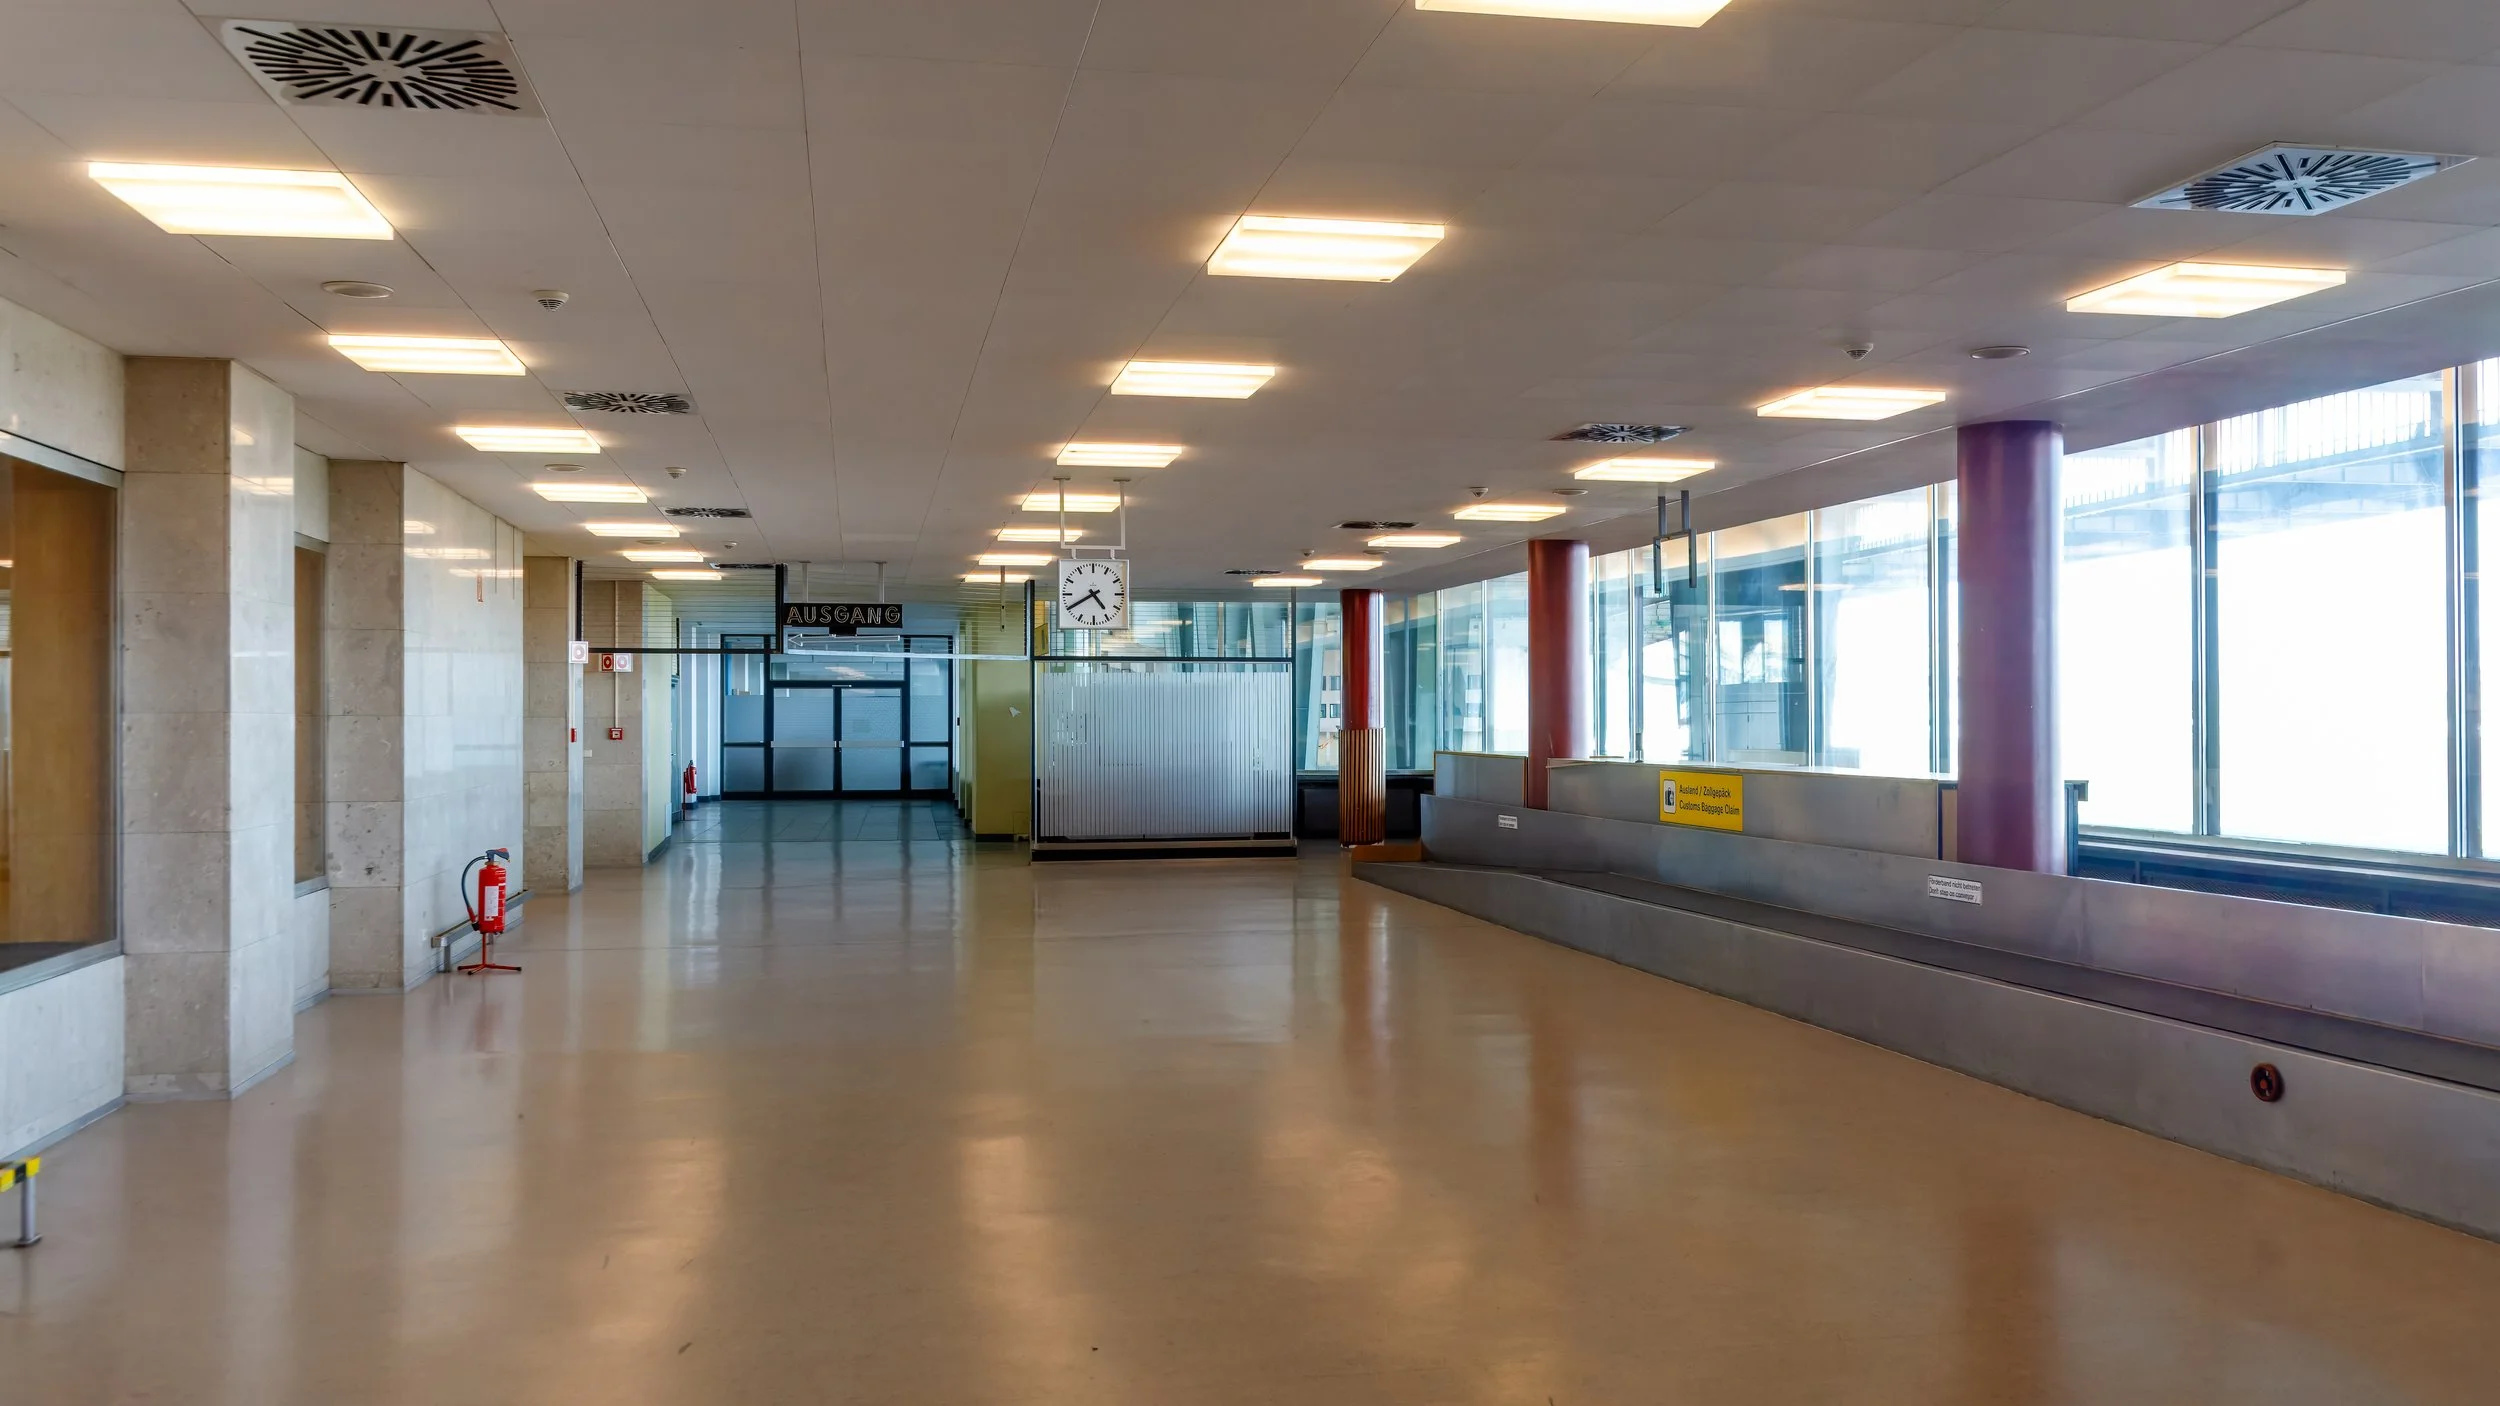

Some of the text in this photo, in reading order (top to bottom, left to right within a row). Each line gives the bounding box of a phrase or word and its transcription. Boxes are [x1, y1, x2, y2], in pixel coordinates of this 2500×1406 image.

[786, 605, 901, 625] AUSGANG
[1679, 785, 1699, 795] Ausland
[1703, 786, 1731, 799] Zollgepäck
[1679, 800, 1740, 815] Customs Baggage Claim
